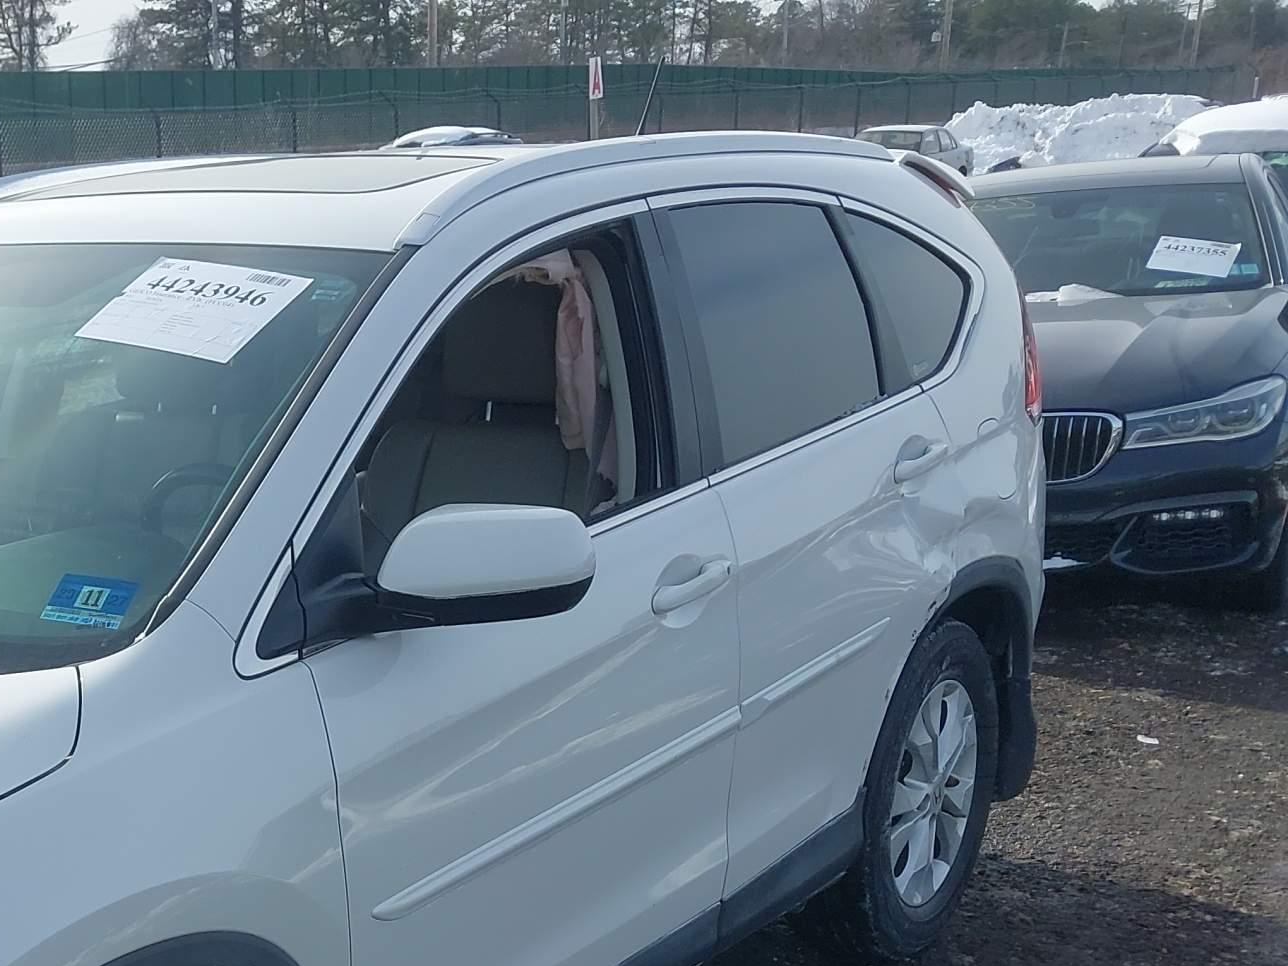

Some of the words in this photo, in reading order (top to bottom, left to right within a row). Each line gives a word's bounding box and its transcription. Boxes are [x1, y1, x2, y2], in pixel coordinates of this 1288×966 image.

[1163, 243, 1229, 257] 44237355
[147, 275, 272, 307] 44243946
[80, 589, 104, 607] 11
